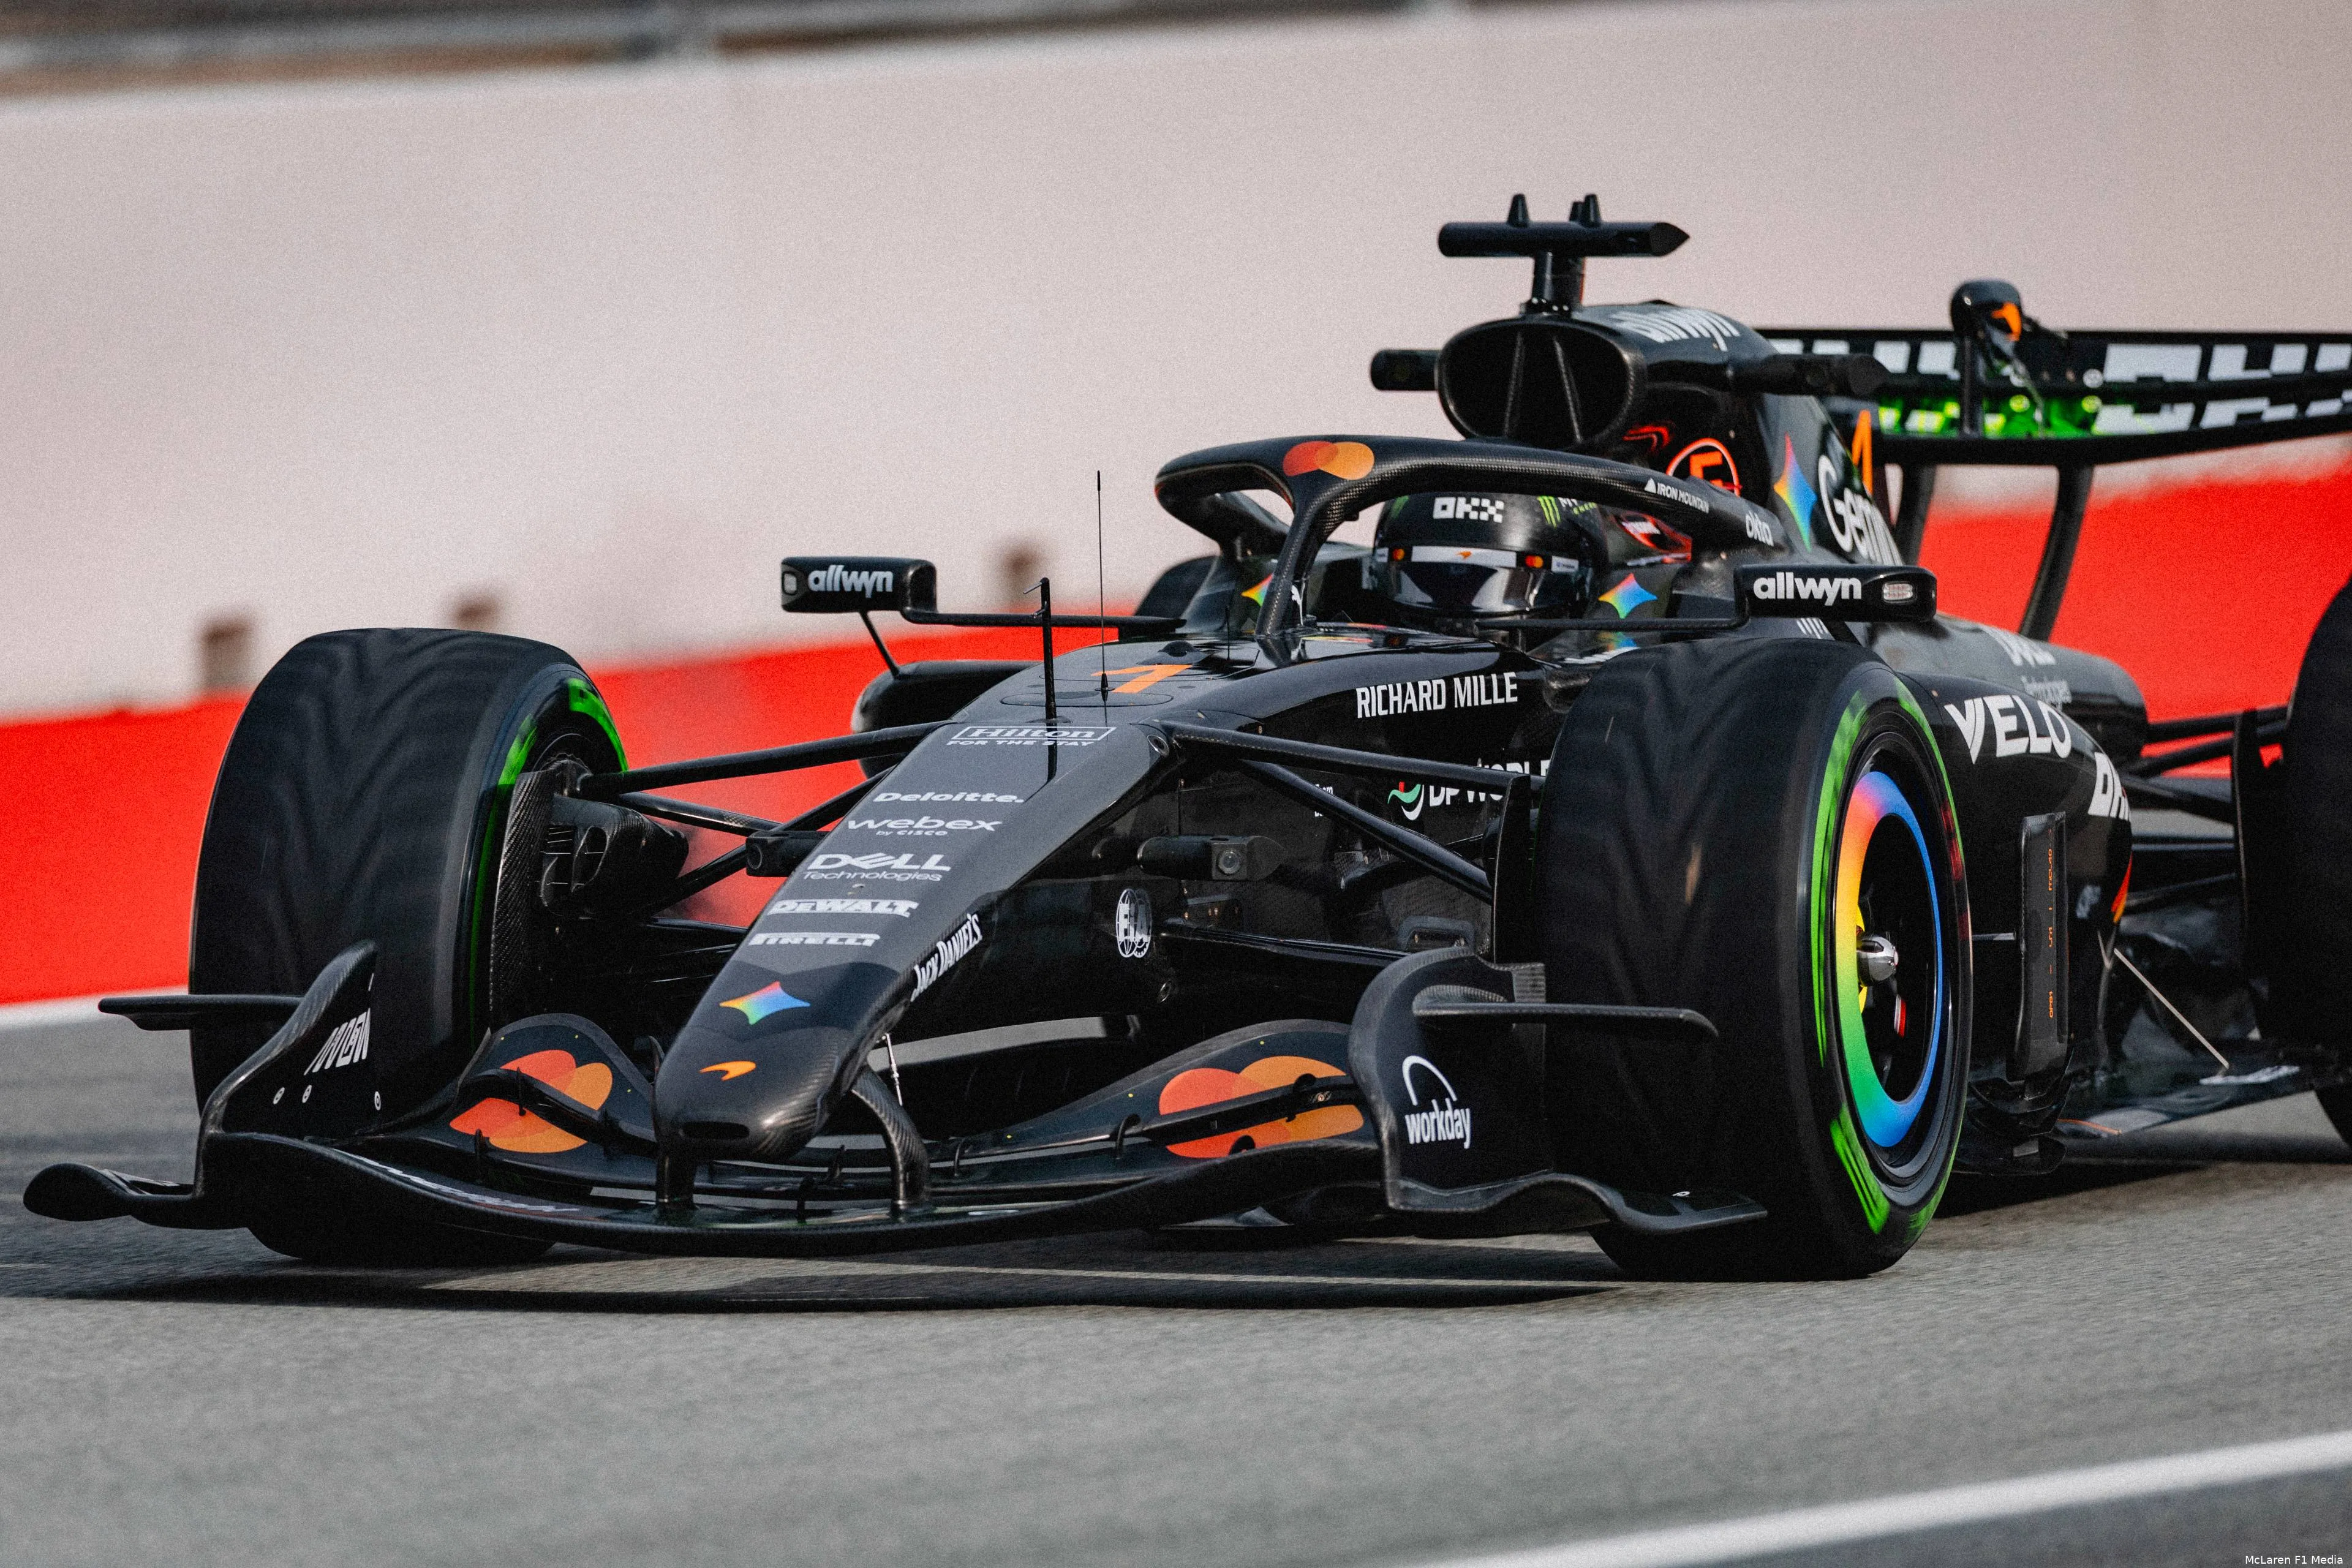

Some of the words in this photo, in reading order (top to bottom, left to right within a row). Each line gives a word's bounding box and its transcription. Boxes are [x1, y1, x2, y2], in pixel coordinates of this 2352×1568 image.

[1433, 497, 1504, 523] OKX
[1657, 482, 1678, 501] IRON
[1678, 490, 1709, 514] MOUNTAIN
[1746, 510, 1774, 546] okta
[808, 565, 893, 598] allwyn
[1753, 572, 1861, 606] allwyn
[1356, 679, 1446, 718] RICHARD
[1453, 672, 1518, 709] MILLE
[967, 729, 1095, 738] Hilton
[1944, 695, 2072, 764] VELO
[848, 816, 1003, 831] webex
[804, 871, 943, 882] Technologies
[807, 853, 951, 872] DELL
[748, 932, 881, 947] PIRELLI
[1405, 1097, 1470, 1149] workday
